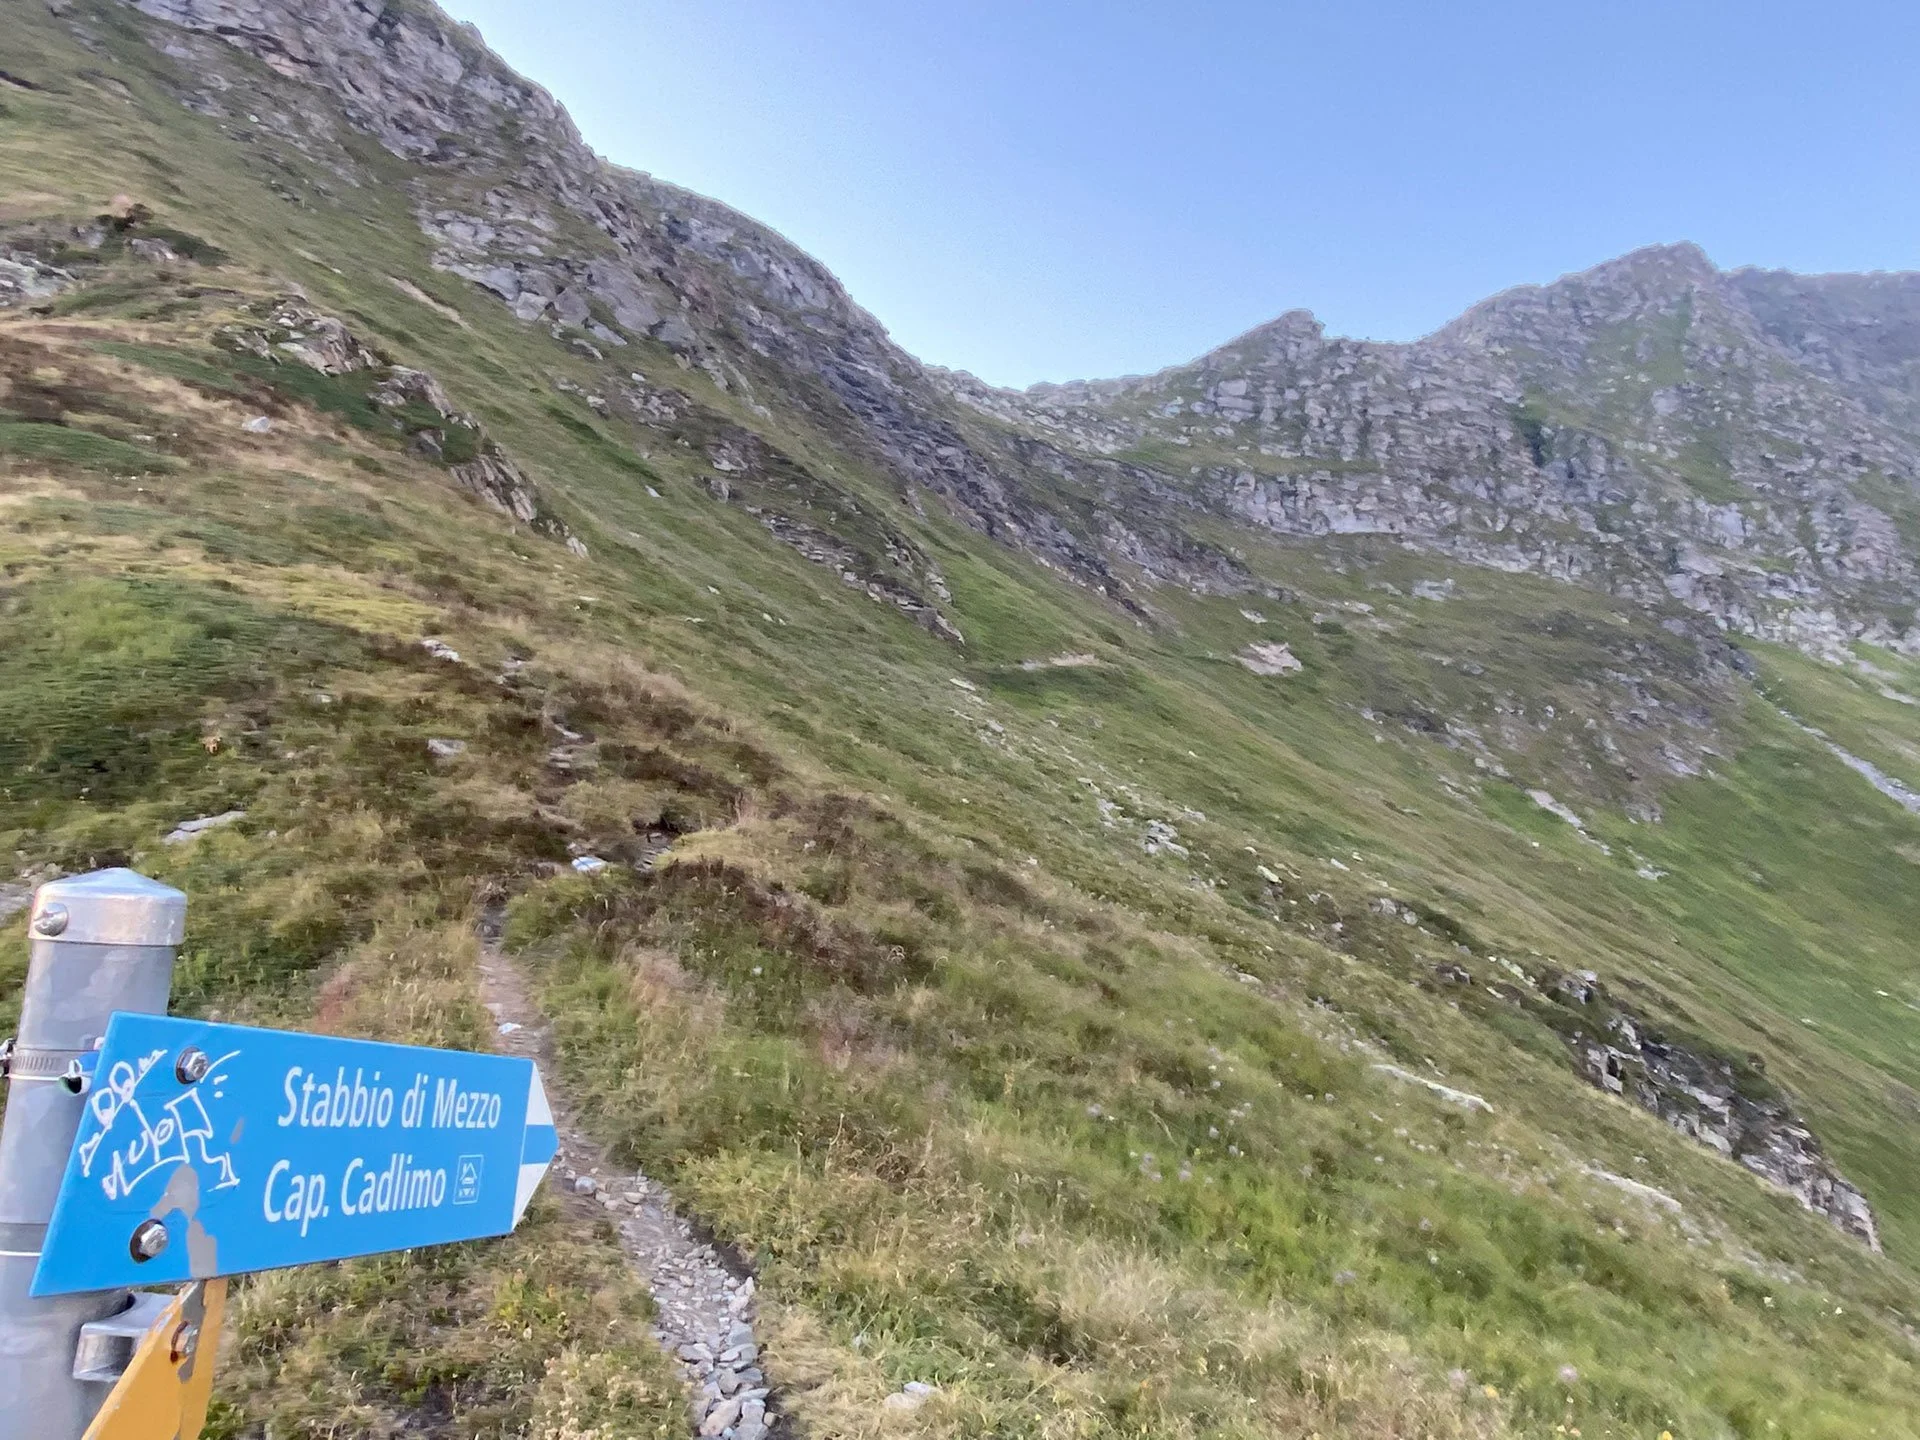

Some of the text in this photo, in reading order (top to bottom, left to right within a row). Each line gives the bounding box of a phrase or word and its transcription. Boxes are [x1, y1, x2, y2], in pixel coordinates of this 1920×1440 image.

[277, 1066, 501, 1130] Stabbio di Mezzo
[263, 1152, 448, 1238] Cap. Cadlimo
